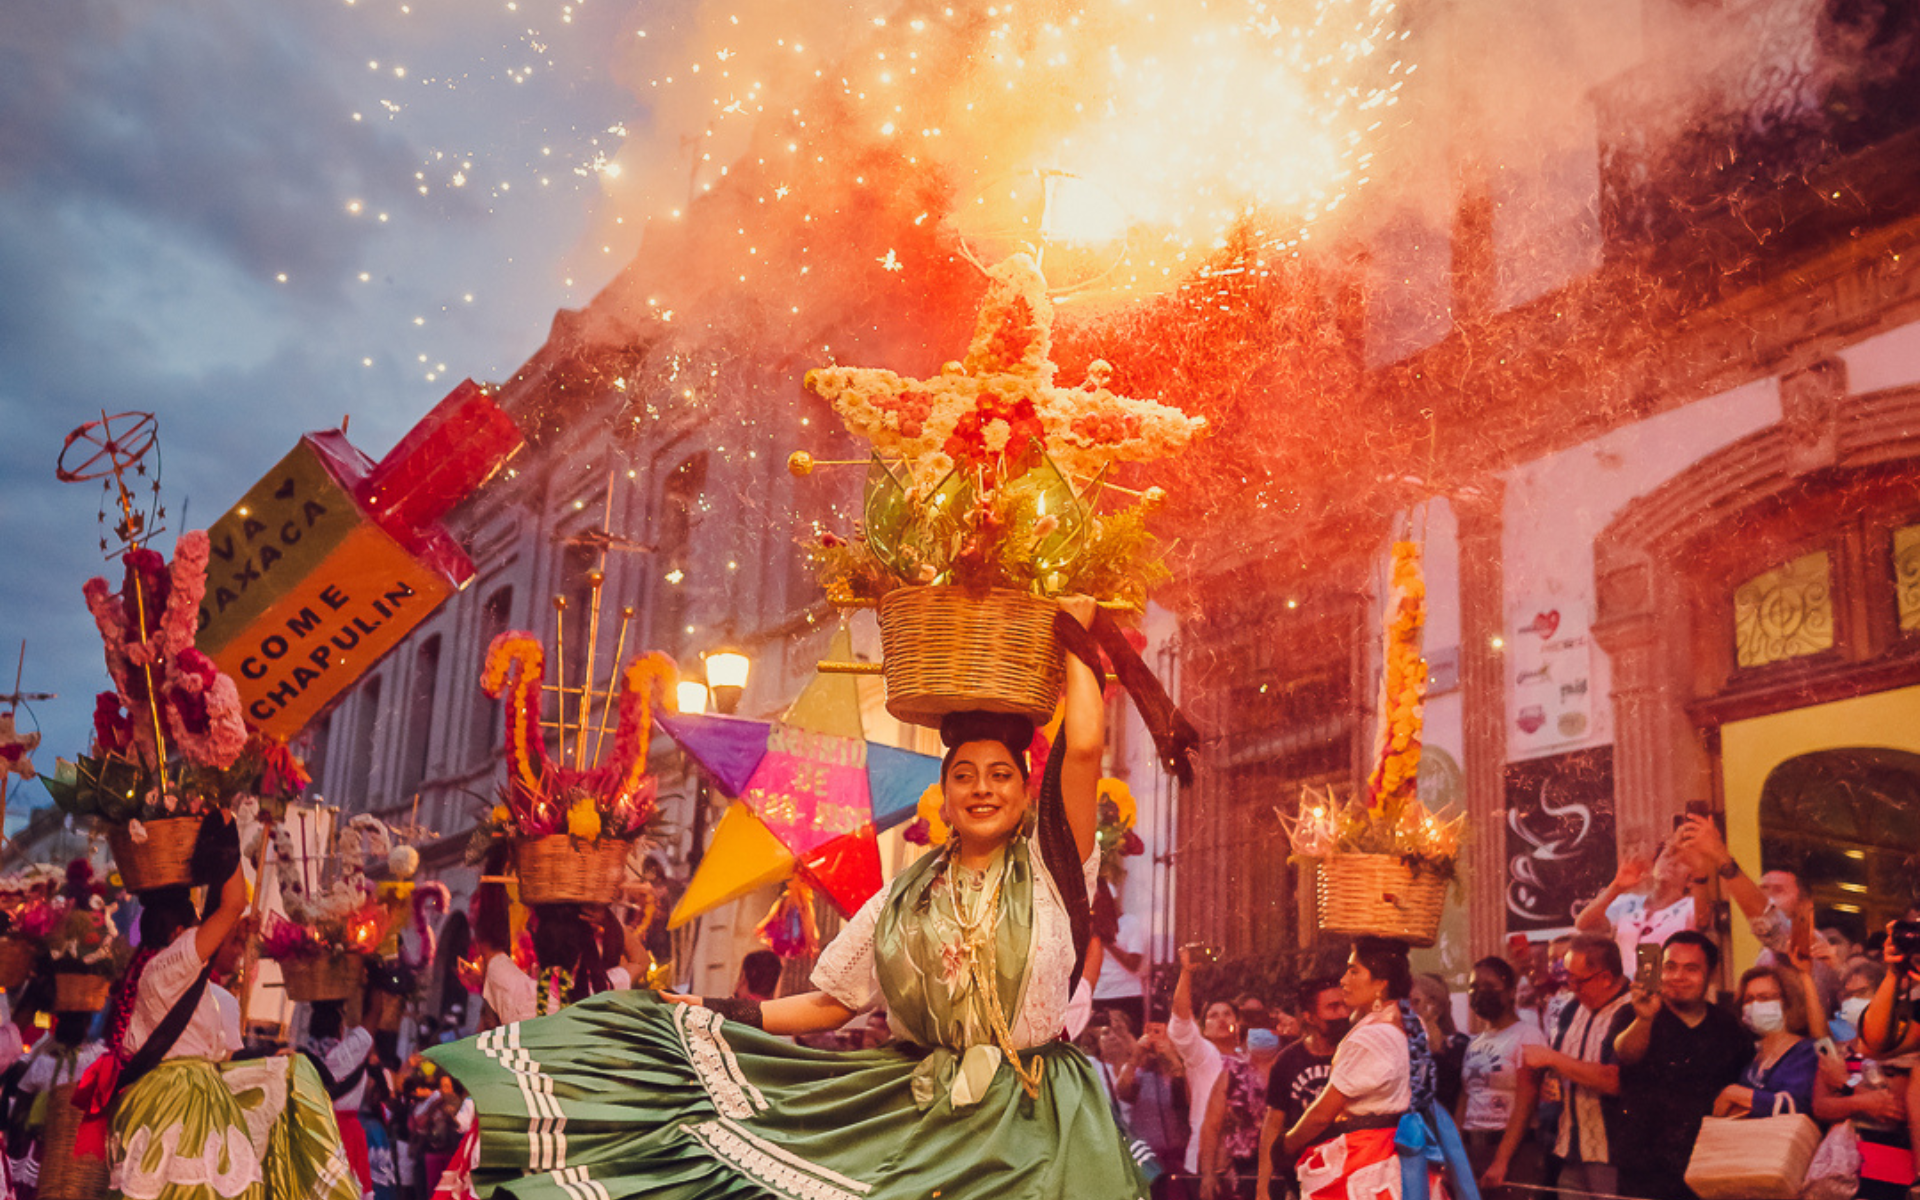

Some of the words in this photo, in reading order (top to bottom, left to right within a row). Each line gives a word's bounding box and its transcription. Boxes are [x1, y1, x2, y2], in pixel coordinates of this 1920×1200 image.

[210, 516, 267, 563] VA
[240, 584, 350, 680] COME
[250, 581, 417, 721] CHAPULIN
